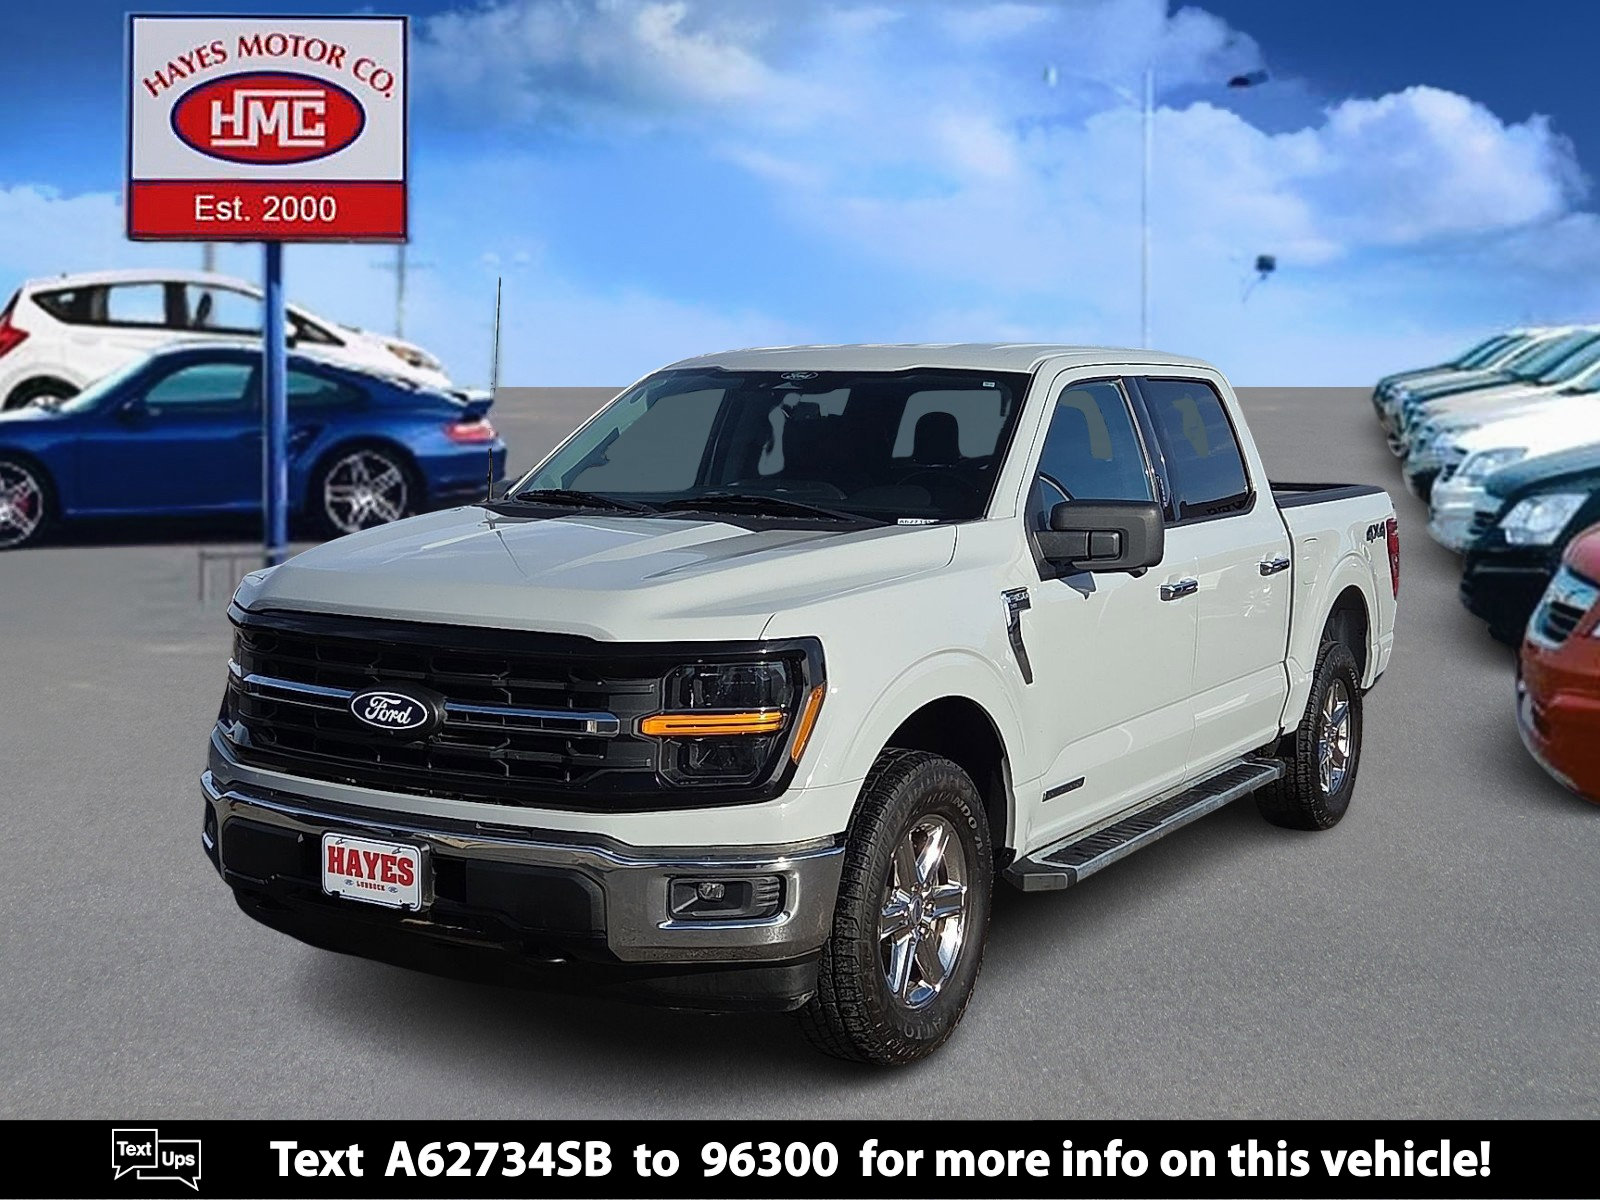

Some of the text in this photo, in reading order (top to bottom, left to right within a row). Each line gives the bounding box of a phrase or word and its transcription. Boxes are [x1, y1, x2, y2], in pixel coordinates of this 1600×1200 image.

[142, 32, 395, 98] HAYES MOTOR CO.
[210, 88, 326, 147] HMC
[194, 194, 337, 222] Est. 2000
[364, 695, 413, 724] Ford
[327, 845, 415, 887] HAYES
